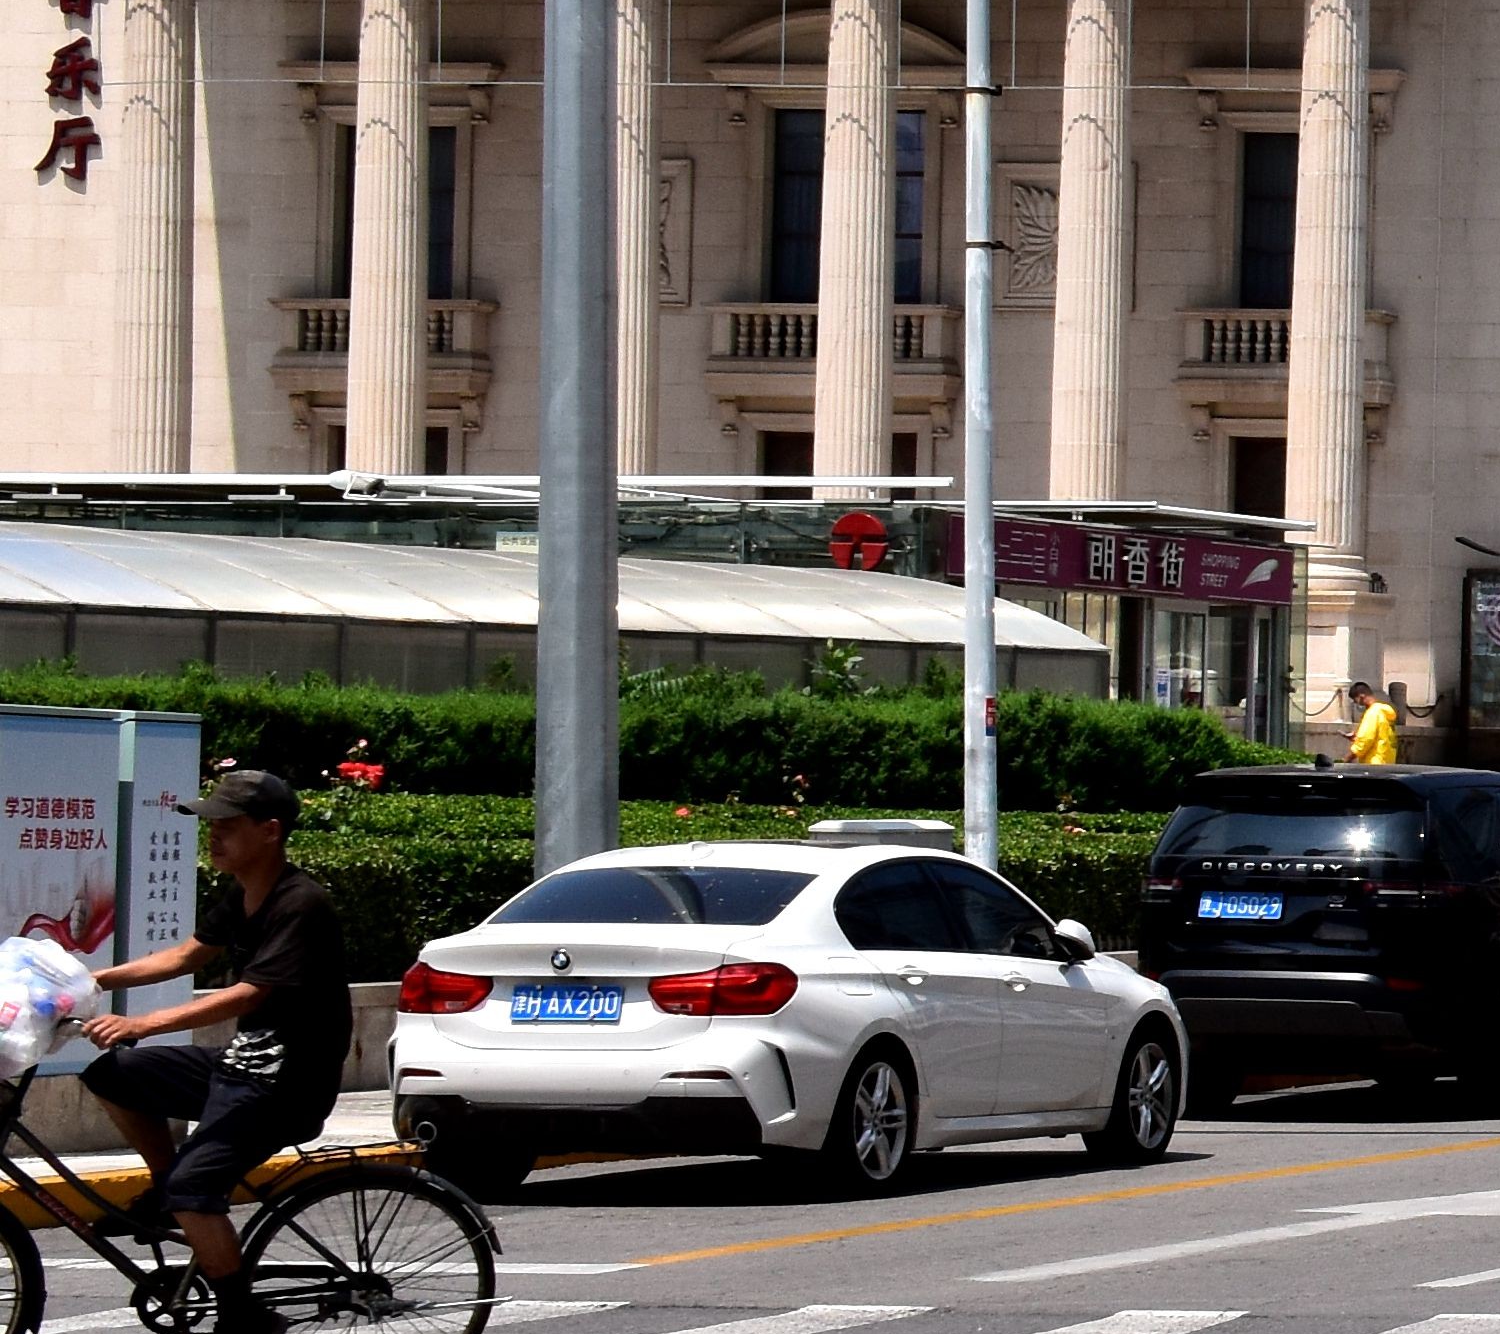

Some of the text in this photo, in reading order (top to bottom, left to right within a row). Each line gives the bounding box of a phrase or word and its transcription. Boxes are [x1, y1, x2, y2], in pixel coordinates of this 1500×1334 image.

[5, 796, 96, 819] 学习道德模范
[19, 828, 108, 850] 点赞身边好人
[1202, 861, 1343, 872] DISCOVERY
